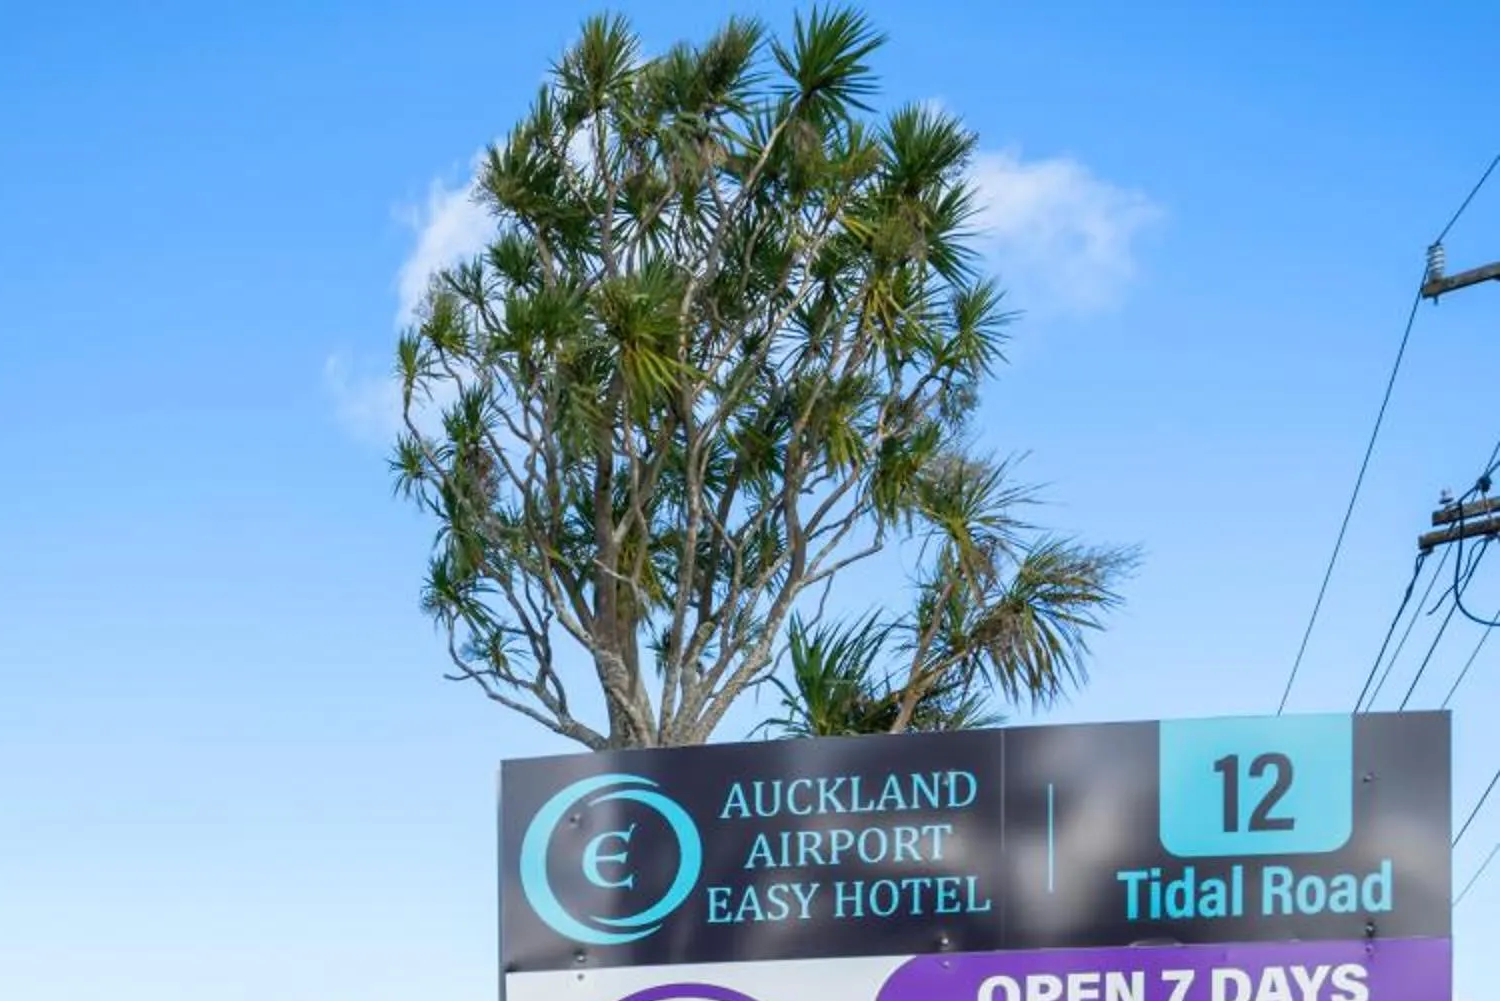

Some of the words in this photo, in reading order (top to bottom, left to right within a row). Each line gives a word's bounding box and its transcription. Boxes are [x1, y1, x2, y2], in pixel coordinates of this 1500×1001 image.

[718, 770, 978, 819] AUCKLAND
[1213, 751, 1295, 833] 12
[744, 824, 952, 869] AIRPORT
[707, 882, 820, 924] EASY
[833, 875, 992, 918] HOTEL
[1116, 864, 1244, 921] Tidal
[1261, 857, 1393, 916] Road
